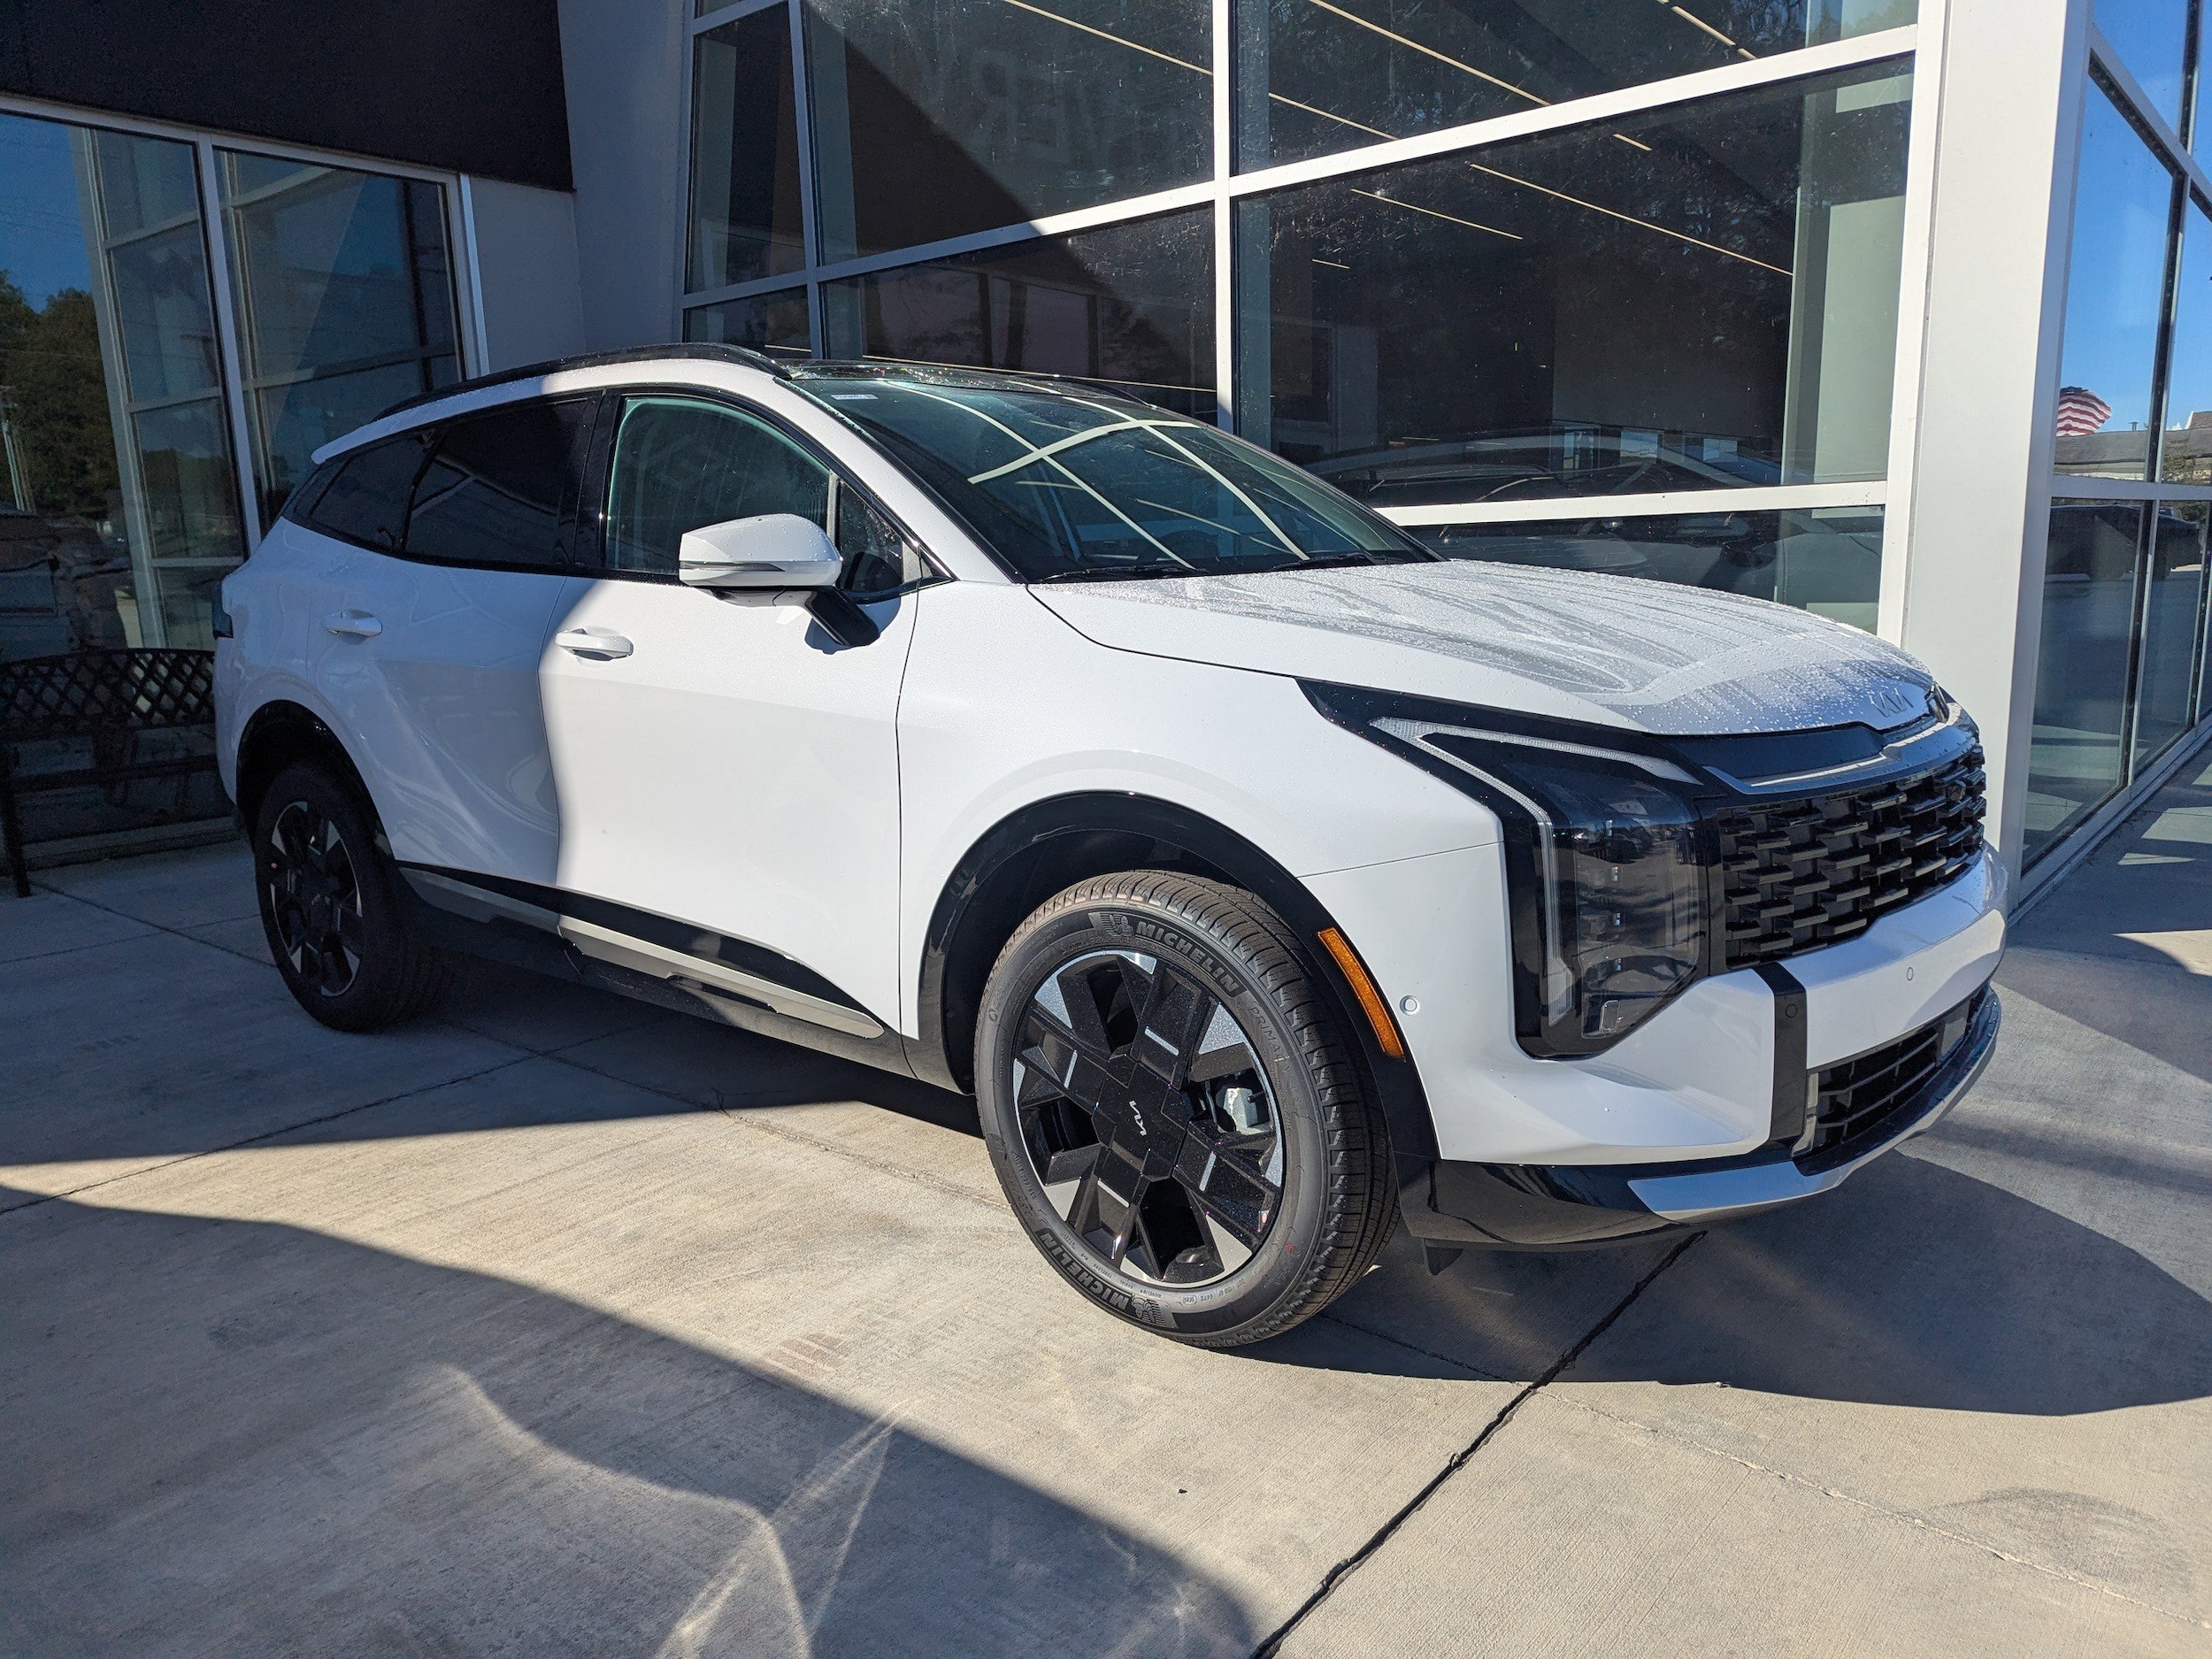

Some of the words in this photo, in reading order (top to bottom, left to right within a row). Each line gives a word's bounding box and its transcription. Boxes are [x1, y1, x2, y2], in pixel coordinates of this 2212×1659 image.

[1136, 921, 1240, 993] MICHELIN
[1250, 1007, 1292, 1074] PRIMACY
[1039, 1232, 1131, 1310] MICHELIN
